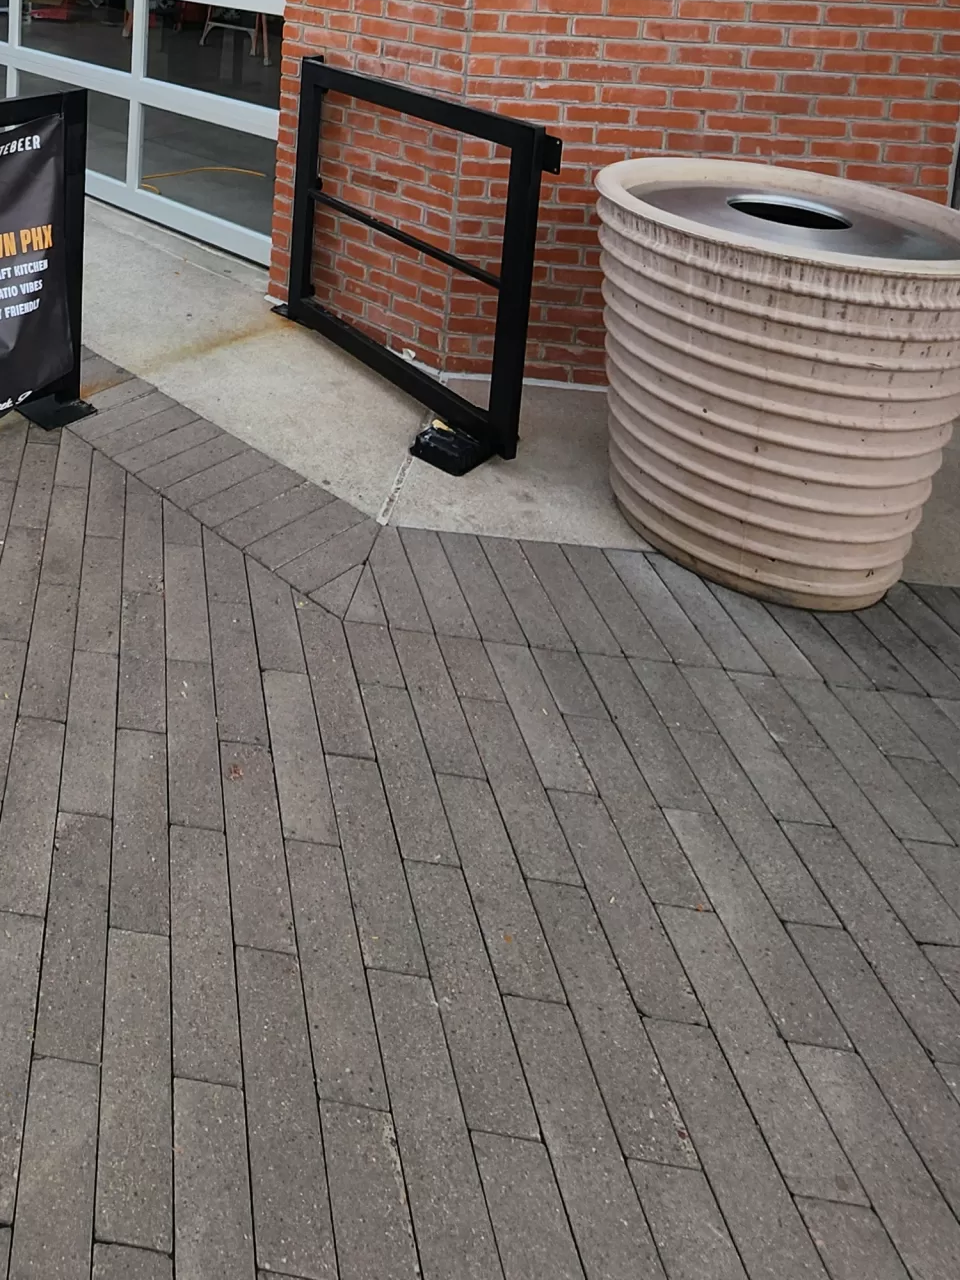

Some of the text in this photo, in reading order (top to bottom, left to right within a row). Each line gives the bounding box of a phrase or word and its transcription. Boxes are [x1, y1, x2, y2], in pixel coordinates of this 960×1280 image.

[20, 224, 53, 254] PHX
[14, 259, 48, 277] KITCHEN
[20, 280, 43, 295] VIBES
[5, 298, 40, 318] FRIENDLY
